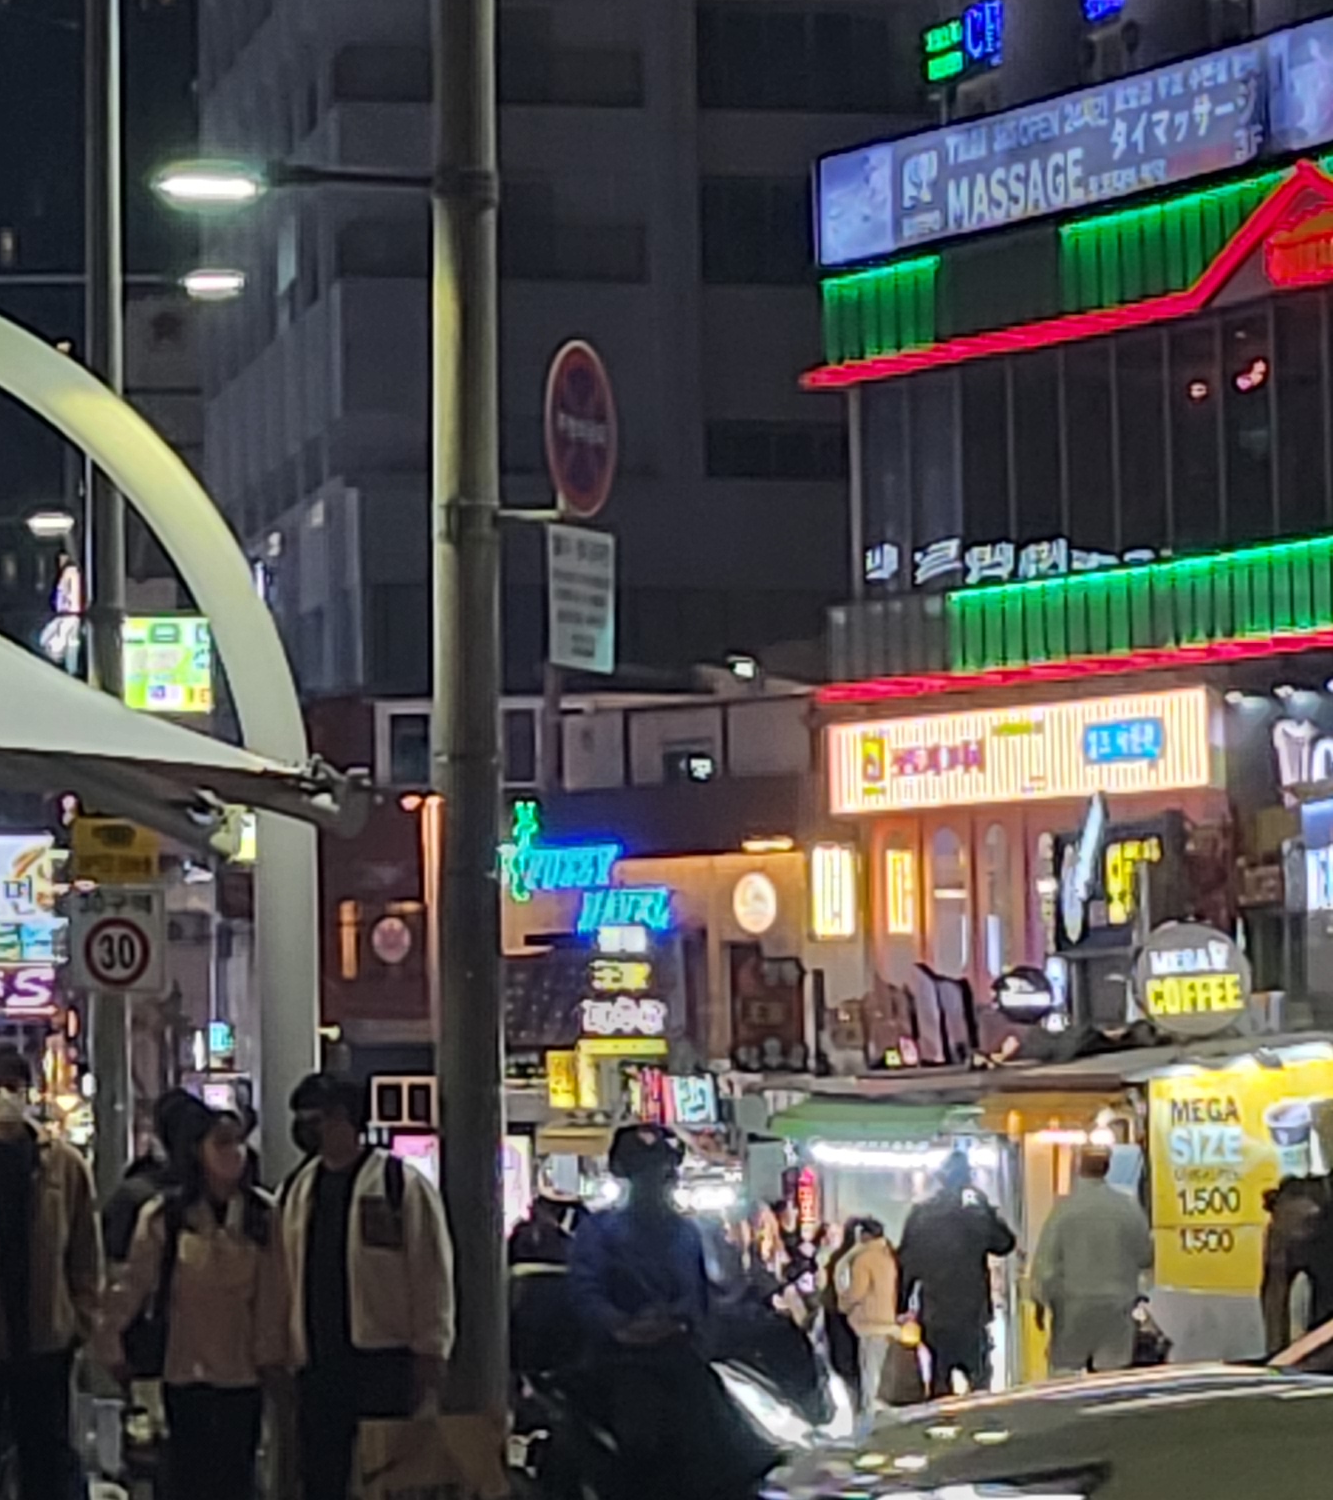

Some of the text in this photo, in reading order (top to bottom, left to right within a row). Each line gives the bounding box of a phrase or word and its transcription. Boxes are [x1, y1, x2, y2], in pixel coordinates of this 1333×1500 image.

[947, 146, 1085, 232] MASSAGE
[98, 933, 135, 971] 30
[1146, 973, 1246, 1015] COFFEE
[1170, 1097, 1240, 1126] MEGA
[1169, 1124, 1244, 1166] SIZE
